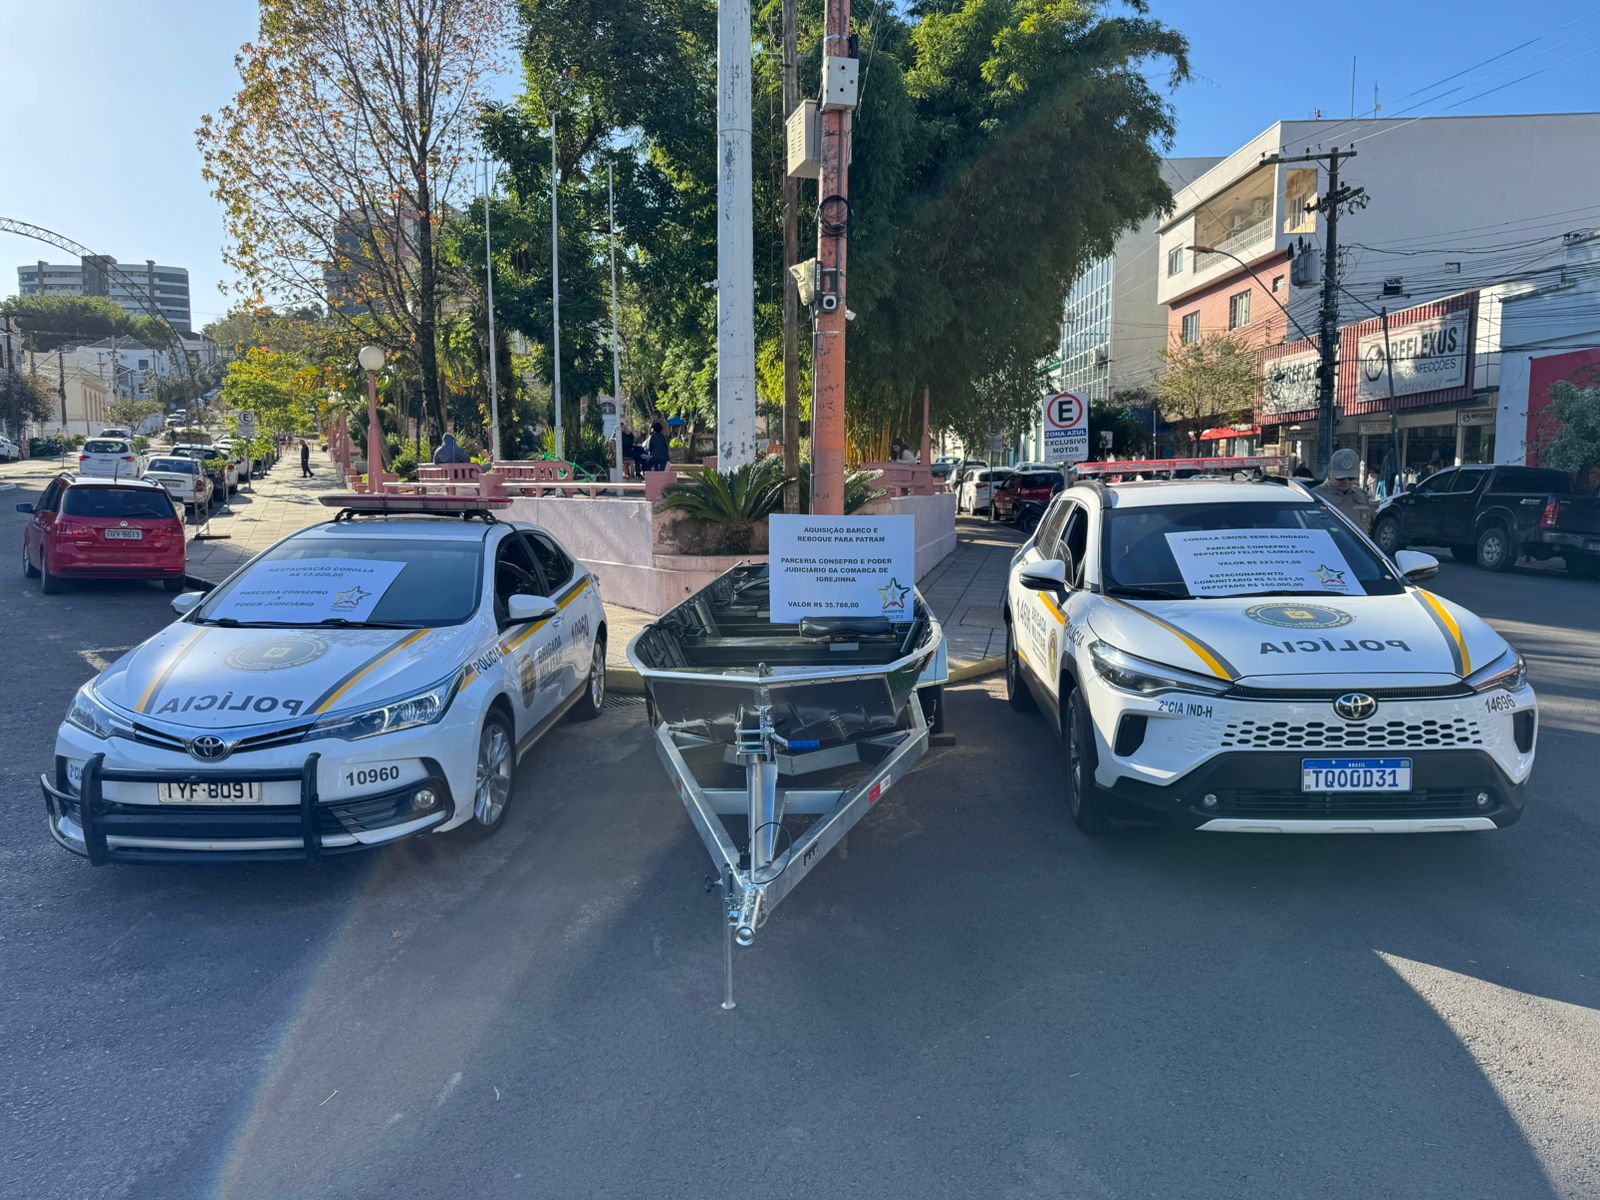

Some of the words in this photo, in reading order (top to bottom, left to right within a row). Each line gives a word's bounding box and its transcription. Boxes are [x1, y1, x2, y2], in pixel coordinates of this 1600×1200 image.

[1390, 326, 1457, 363] REFLEXUS
[243, 413, 250, 422] E
[1058, 400, 1074, 422] E
[1045, 438, 1087, 447] EXCLUSIVO
[1052, 446, 1079, 454] MOTOS
[803, 526, 845, 535] AQUISIÇÃO
[473, 646, 505, 675] POLÍCIA
[1186, 703, 1213, 719] IND-H
[1485, 694, 1516, 714] 14696
[346, 765, 400, 786] 10960
